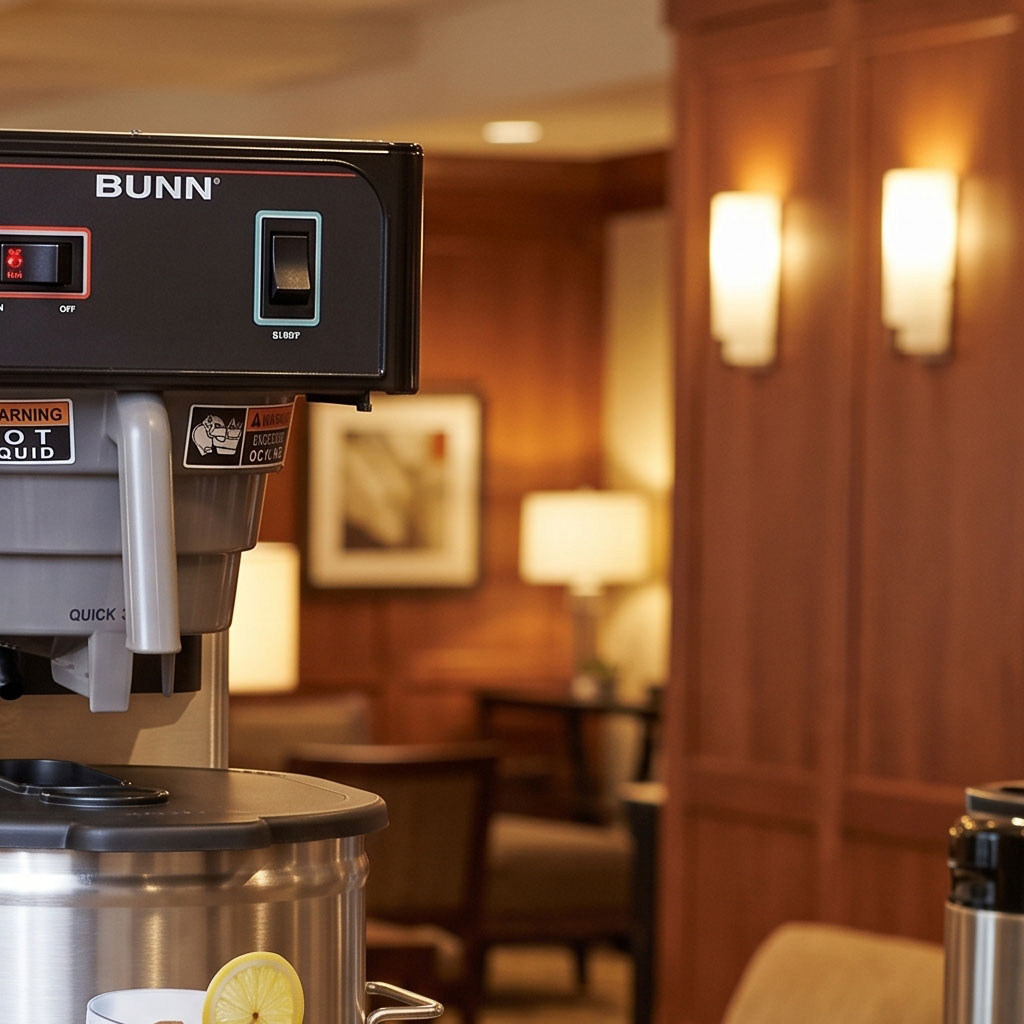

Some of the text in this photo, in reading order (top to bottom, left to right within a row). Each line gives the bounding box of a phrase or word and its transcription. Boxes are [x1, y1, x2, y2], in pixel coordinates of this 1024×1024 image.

[96, 174, 212, 200] BUNN
[59, 305, 76, 313] OFF
[69, 608, 116, 621] QUICK
